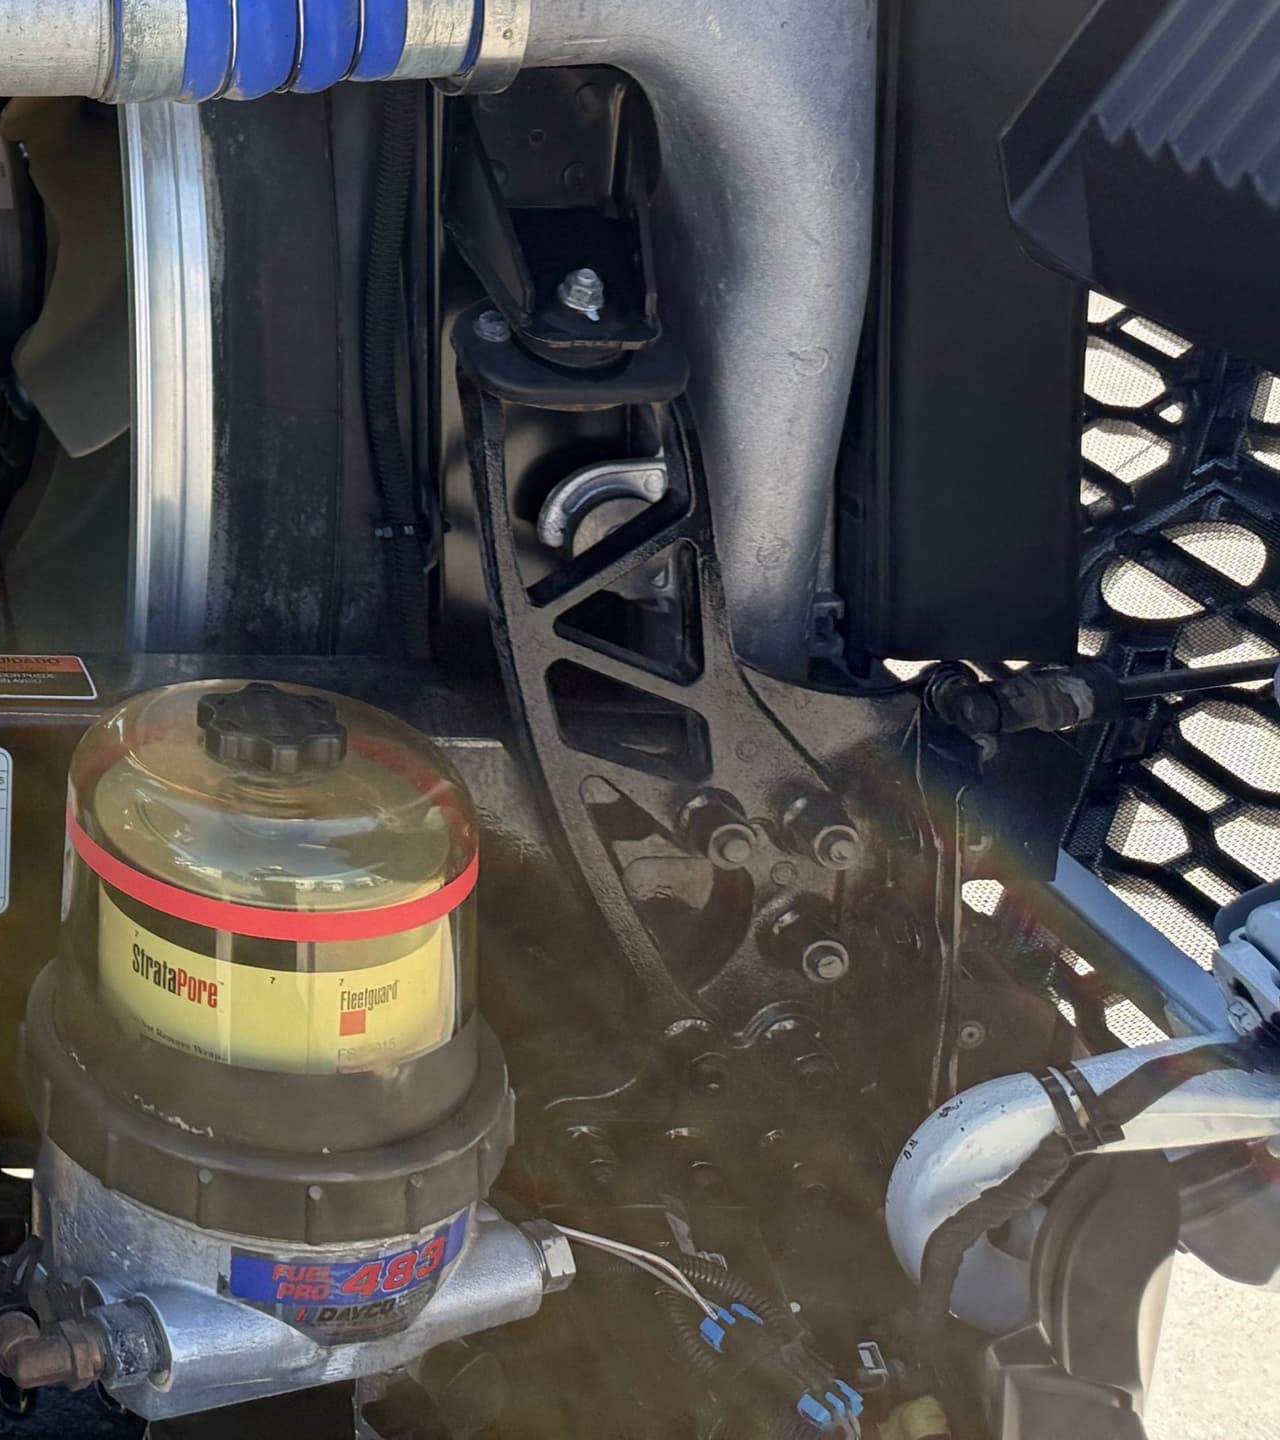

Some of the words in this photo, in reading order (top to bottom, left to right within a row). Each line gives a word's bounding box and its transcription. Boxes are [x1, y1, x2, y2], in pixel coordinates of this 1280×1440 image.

[132, 943, 218, 1009] StrataPore
[340, 982, 399, 1011] Fleetguard
[272, 1263, 332, 1282] FUEL
[276, 1282, 331, 1301] PRO
